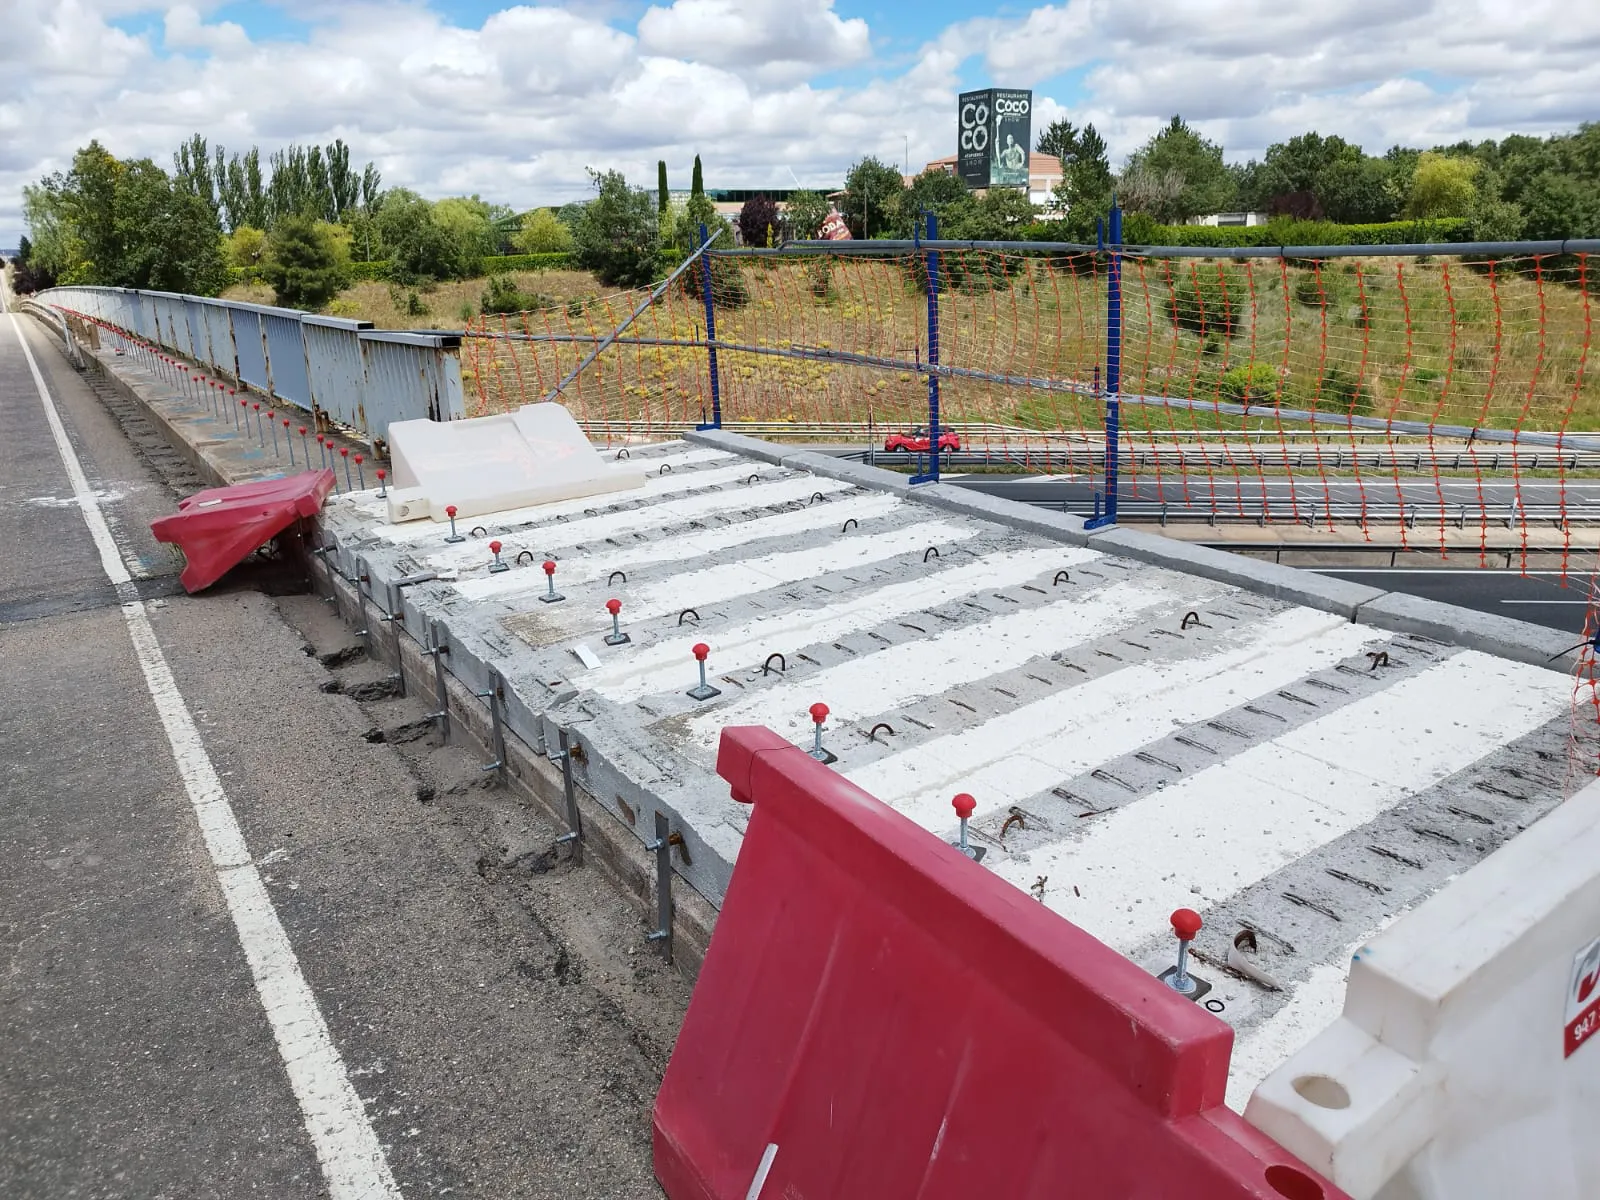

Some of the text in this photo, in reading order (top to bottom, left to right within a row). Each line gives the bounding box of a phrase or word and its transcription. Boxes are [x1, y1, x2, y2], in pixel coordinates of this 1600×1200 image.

[961, 103, 989, 128] CO
[961, 125, 988, 151] CO
[1574, 1011, 1596, 1040] 947
